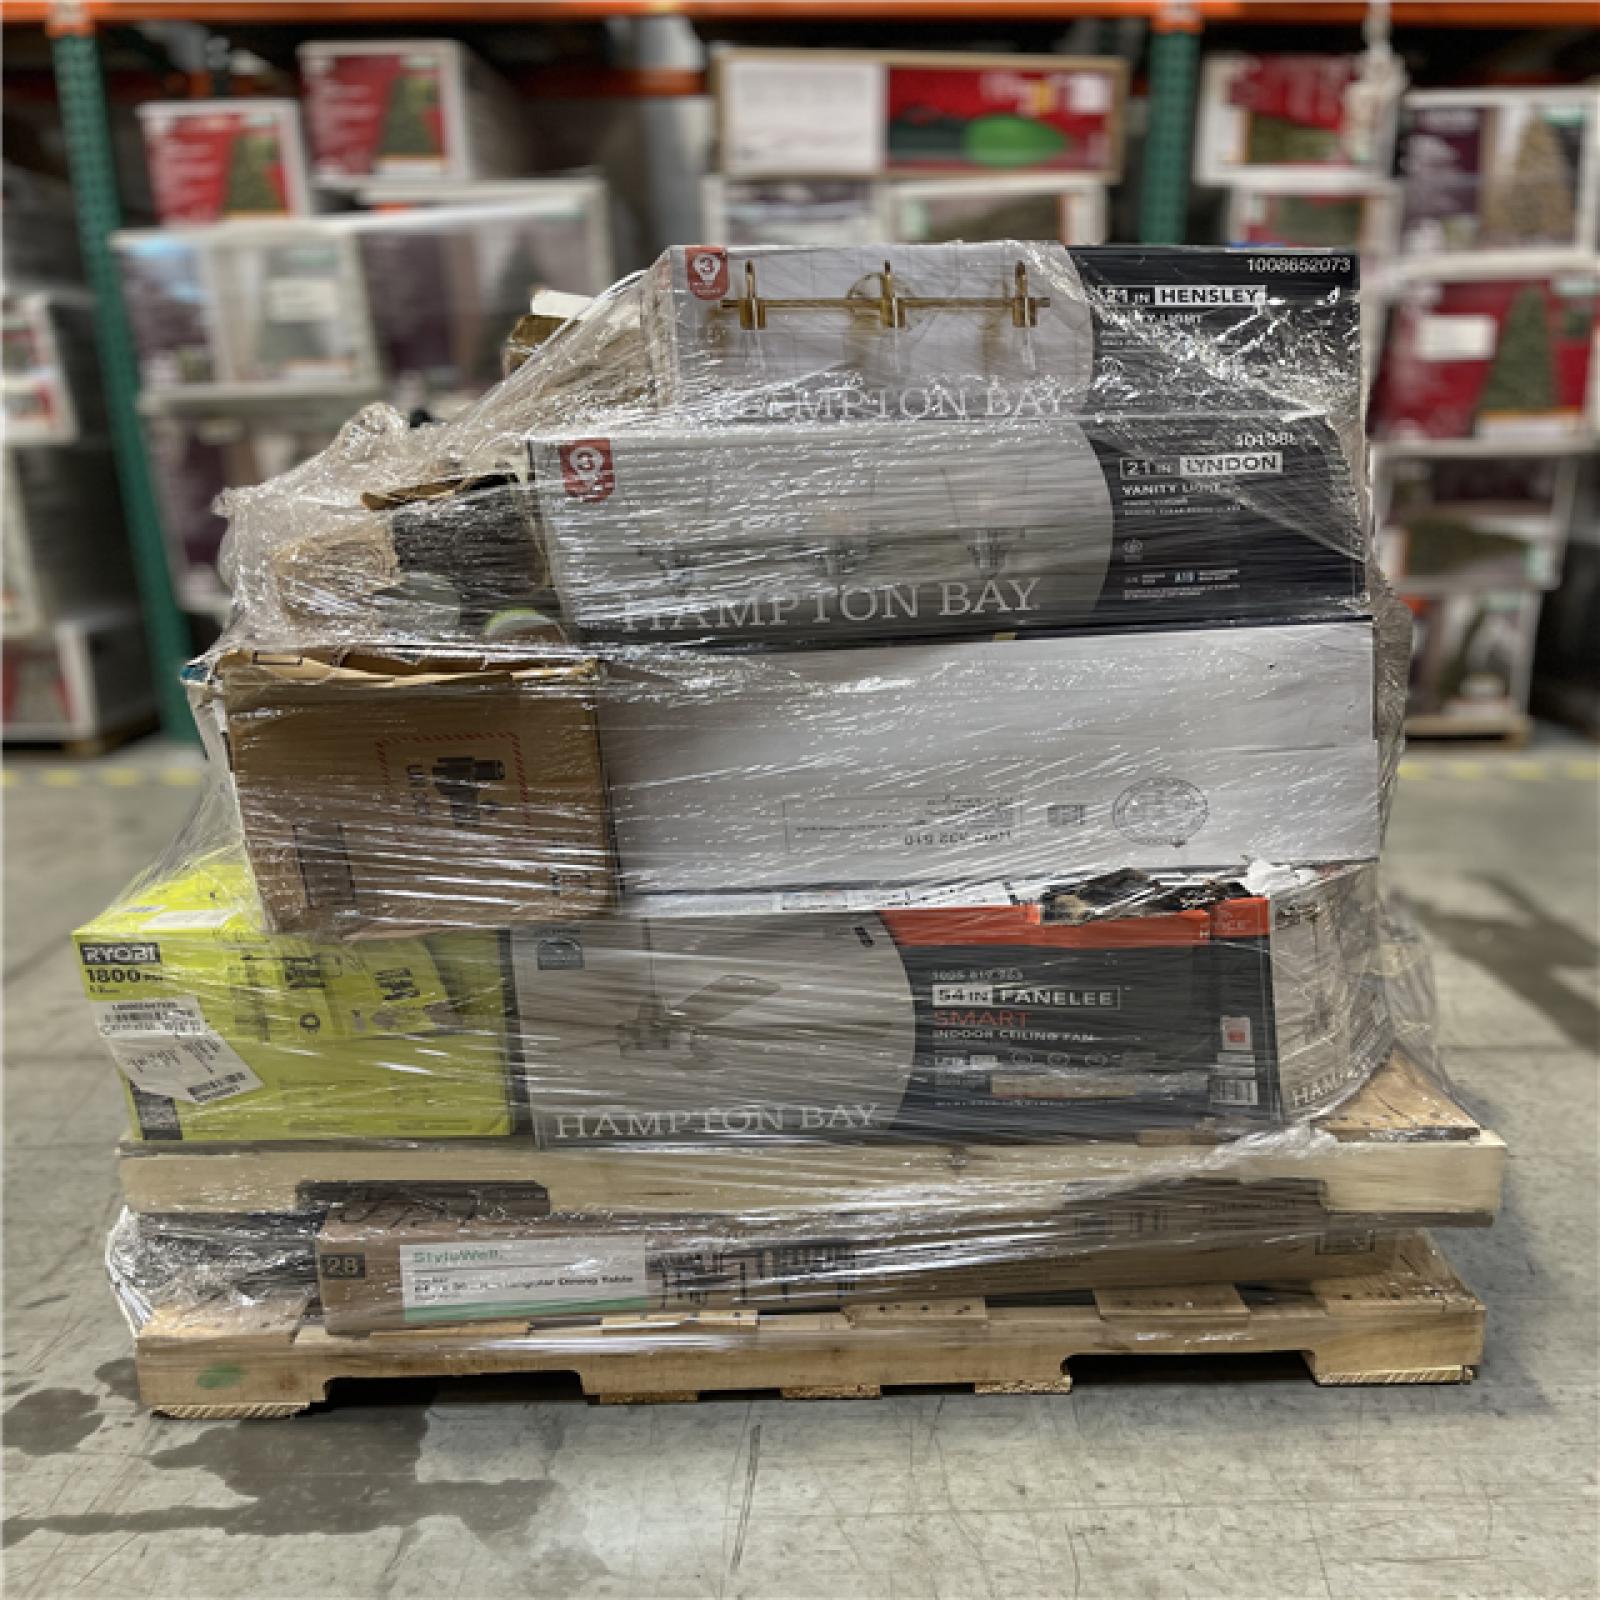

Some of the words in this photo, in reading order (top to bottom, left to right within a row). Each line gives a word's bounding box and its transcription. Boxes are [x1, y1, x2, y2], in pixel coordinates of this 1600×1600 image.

[1161, 289, 1258, 303] HENSLEY
[1186, 456, 1276, 473] LYNDON
[938, 577, 1040, 616] BAY
[83, 947, 157, 962] RYOBI
[87, 968, 141, 983] 1800
[932, 1010, 1031, 1029] SMART
[800, 1103, 880, 1129] BAY
